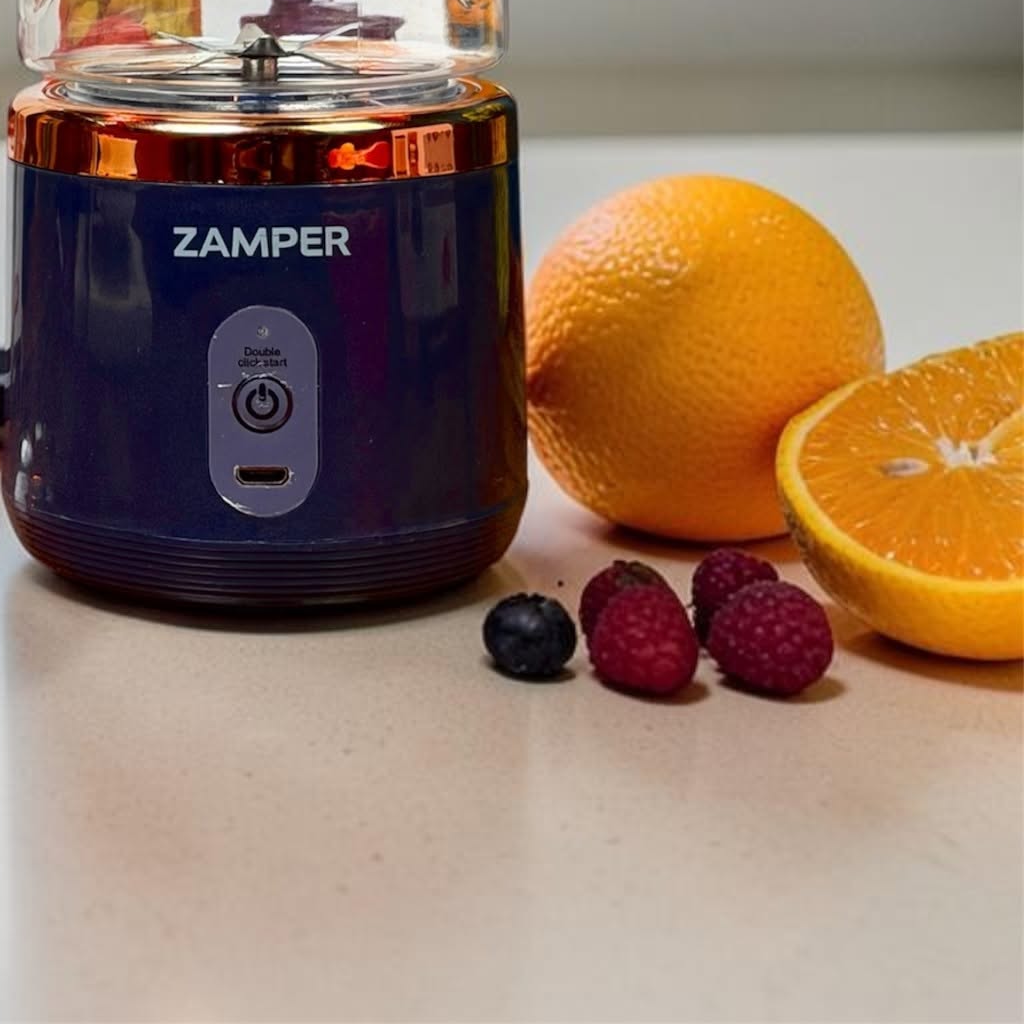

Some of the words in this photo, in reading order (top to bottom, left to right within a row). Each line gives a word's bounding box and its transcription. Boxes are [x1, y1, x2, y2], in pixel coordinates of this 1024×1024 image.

[173, 226, 352, 258] ZAMPER
[244, 346, 281, 357] Double
[237, 358, 262, 368] click
[262, 358, 288, 368] start
